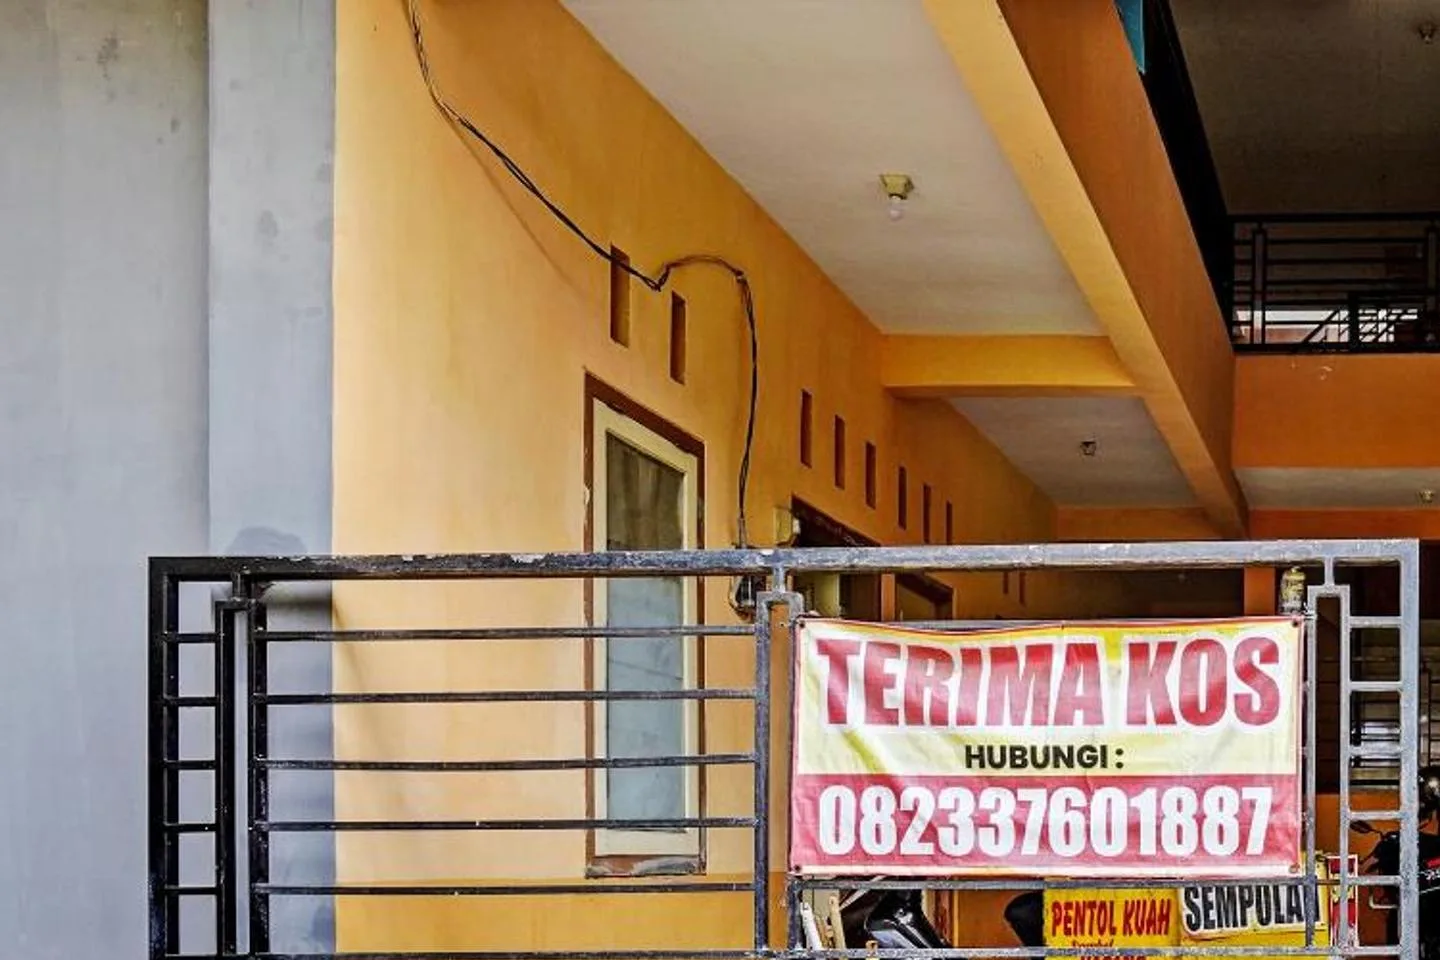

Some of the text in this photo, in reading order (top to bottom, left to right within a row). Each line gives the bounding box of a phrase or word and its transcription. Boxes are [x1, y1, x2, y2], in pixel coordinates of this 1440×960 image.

[815, 636, 1281, 727] TERIMA KOS
[818, 784, 1273, 857] 082337601887
[1051, 898, 1172, 937] PENTOL KUAH
